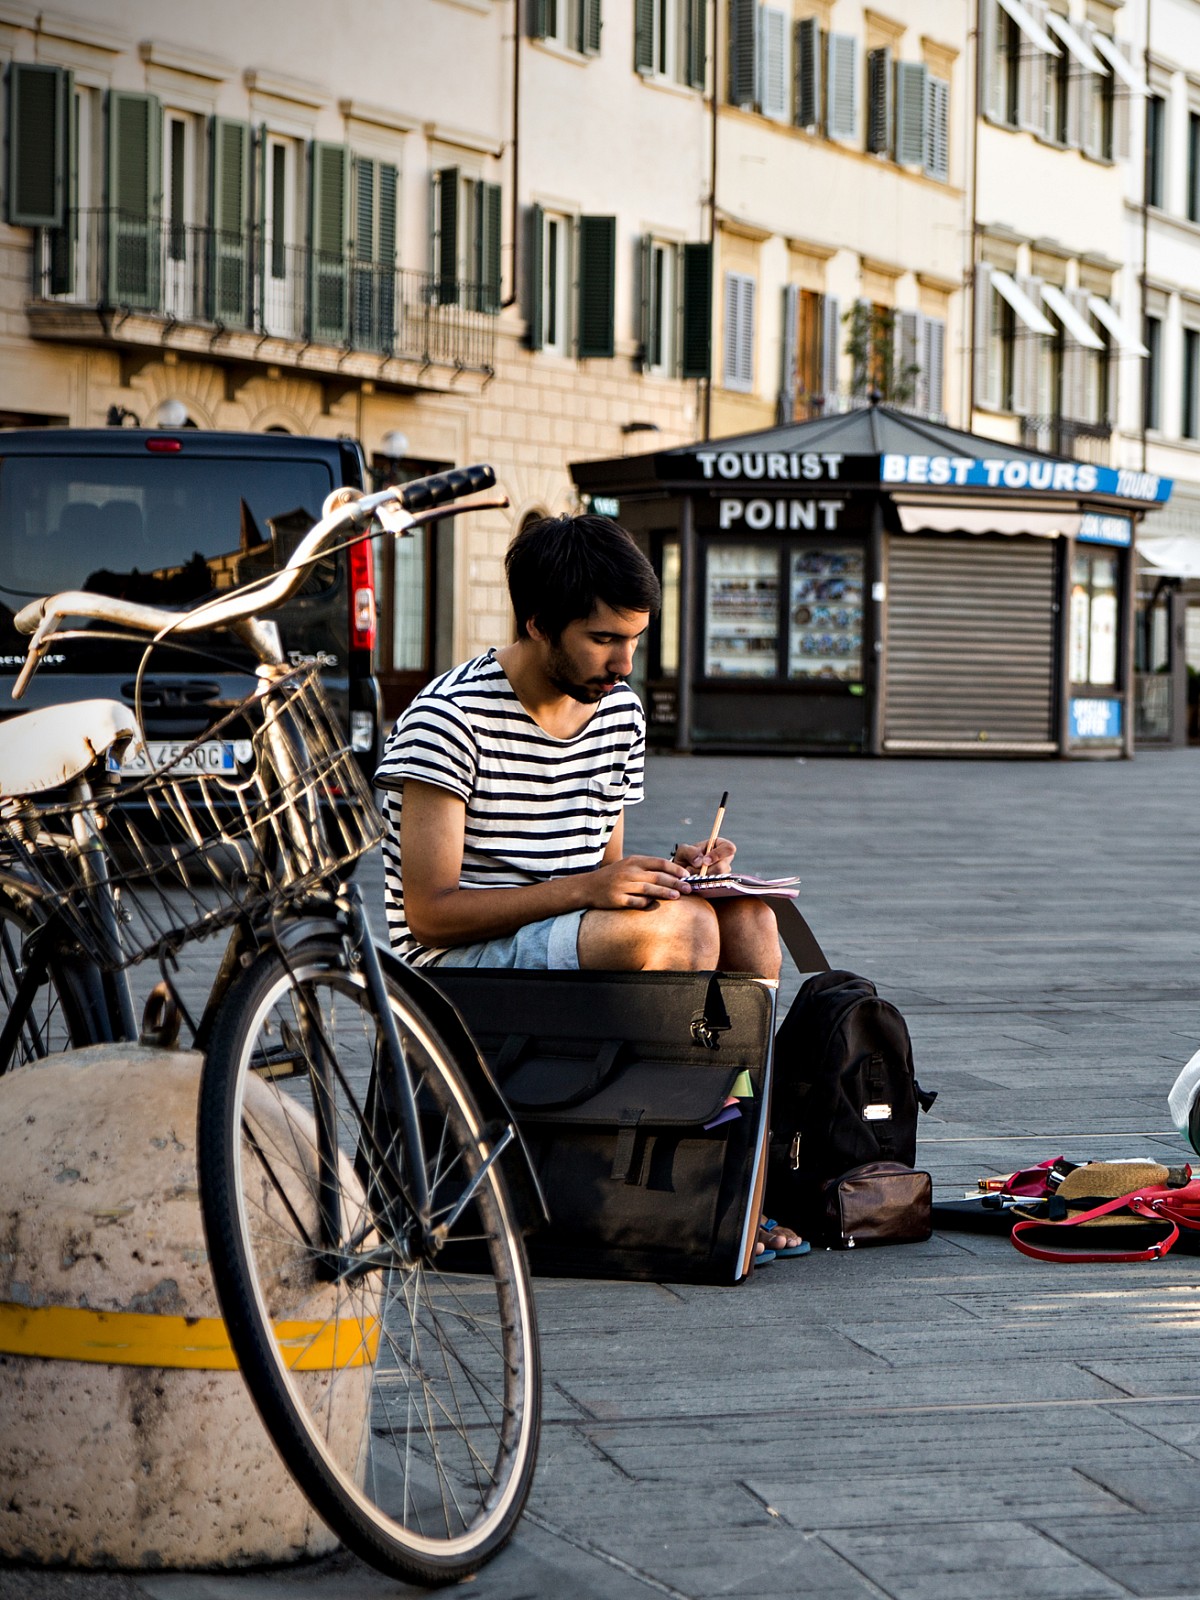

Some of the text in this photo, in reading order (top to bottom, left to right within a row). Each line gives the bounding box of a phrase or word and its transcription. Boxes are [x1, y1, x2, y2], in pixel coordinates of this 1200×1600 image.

[696, 452, 844, 480] TOURIST
[882, 453, 1099, 492] BEST TOURS
[719, 499, 845, 531] POINT
